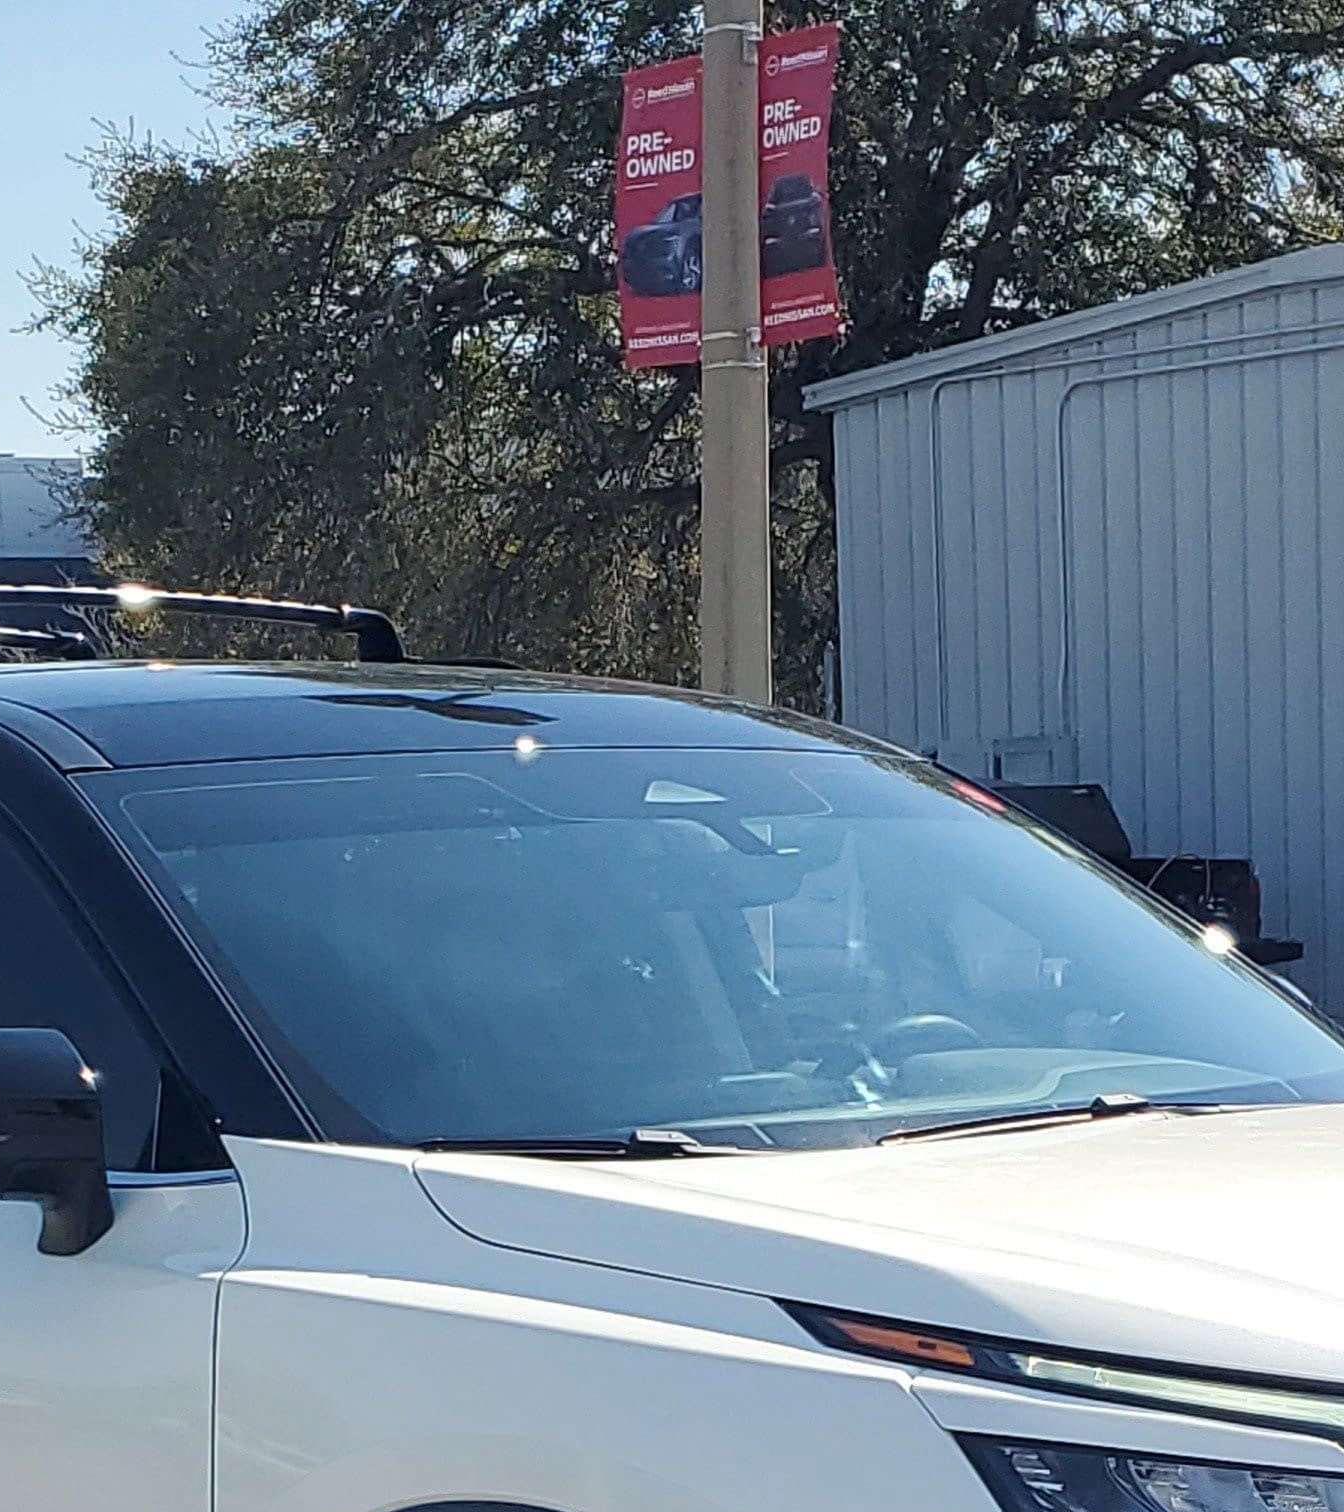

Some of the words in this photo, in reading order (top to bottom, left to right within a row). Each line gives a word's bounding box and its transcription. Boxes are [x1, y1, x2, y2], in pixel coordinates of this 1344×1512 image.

[763, 98, 802, 126] PRE-
[626, 131, 673, 156] PRE-
[762, 116, 821, 148] OWNED
[626, 149, 695, 178] OWNED
